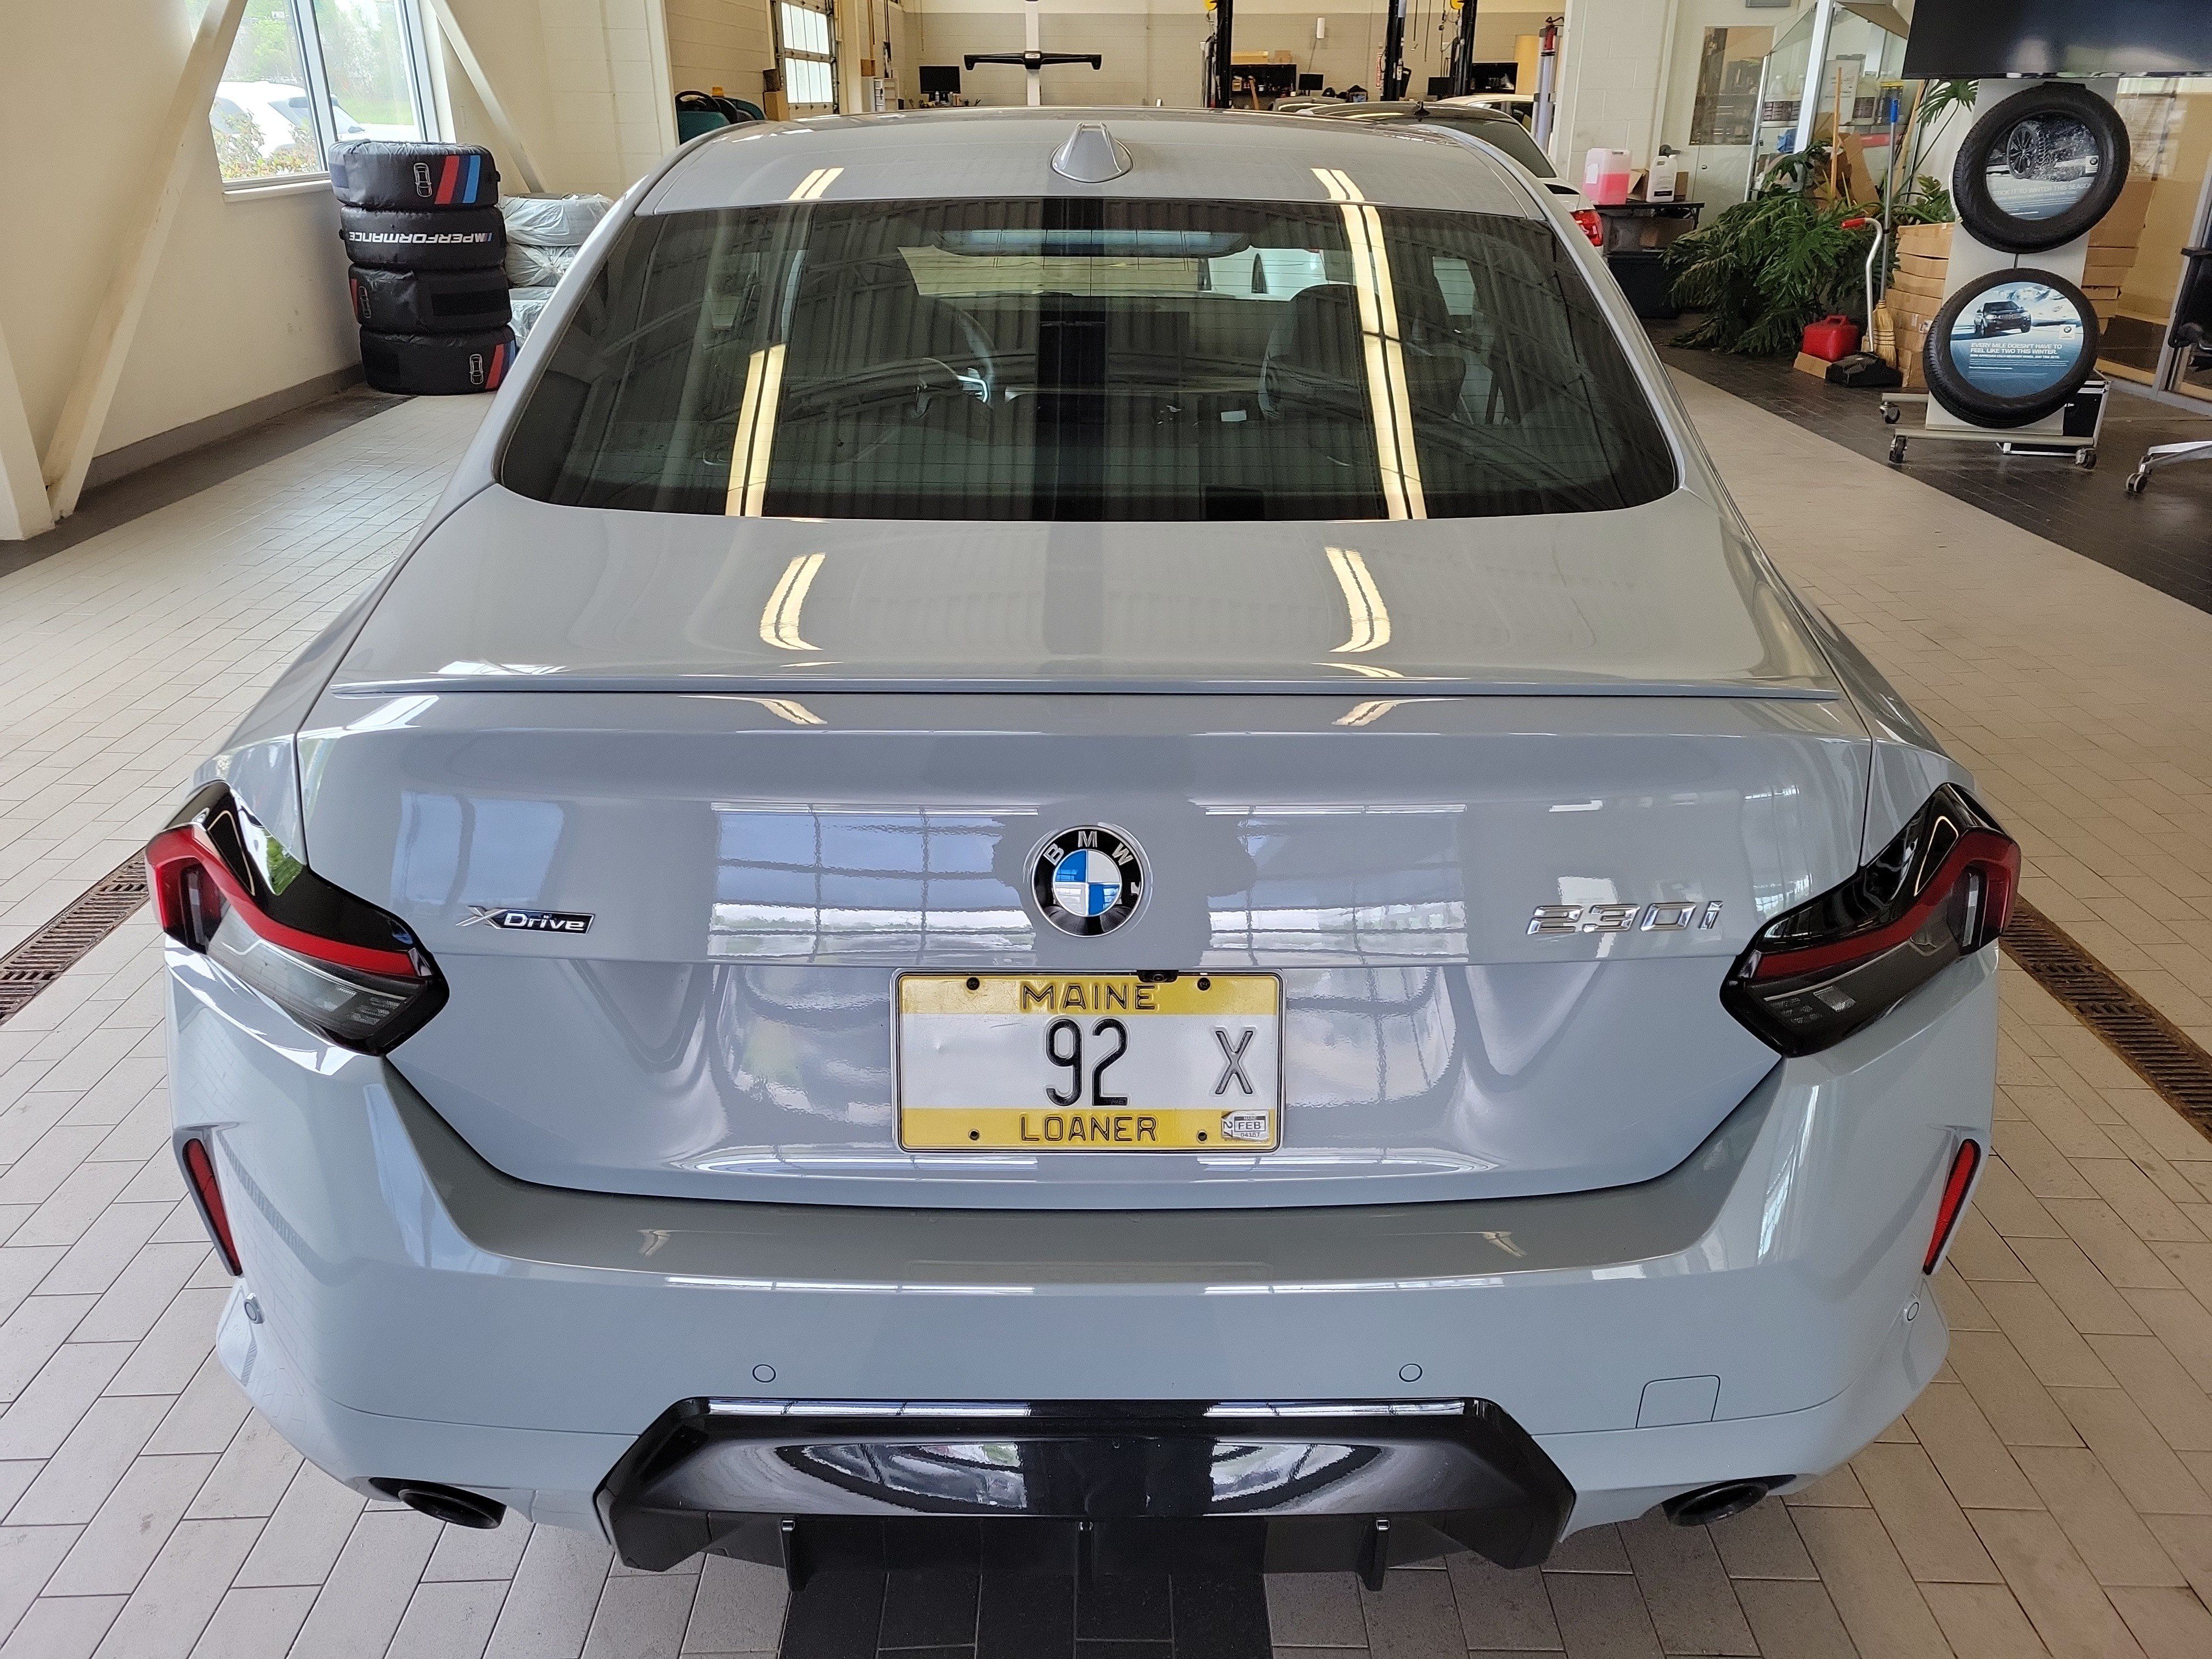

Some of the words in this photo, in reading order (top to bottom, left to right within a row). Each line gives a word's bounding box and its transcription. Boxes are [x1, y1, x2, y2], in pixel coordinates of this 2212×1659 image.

[1043, 831, 1133, 866] BMW
[1527, 901, 1723, 935] 230i
[1022, 985, 1155, 1010] MAINE
[1046, 1018, 1128, 1107] 92
[1215, 1030, 1254, 1095] X
[1021, 1116, 1156, 1142] LOANER
[1223, 1121, 1233, 1138] 27
[1238, 1121, 1261, 1130] FEB
